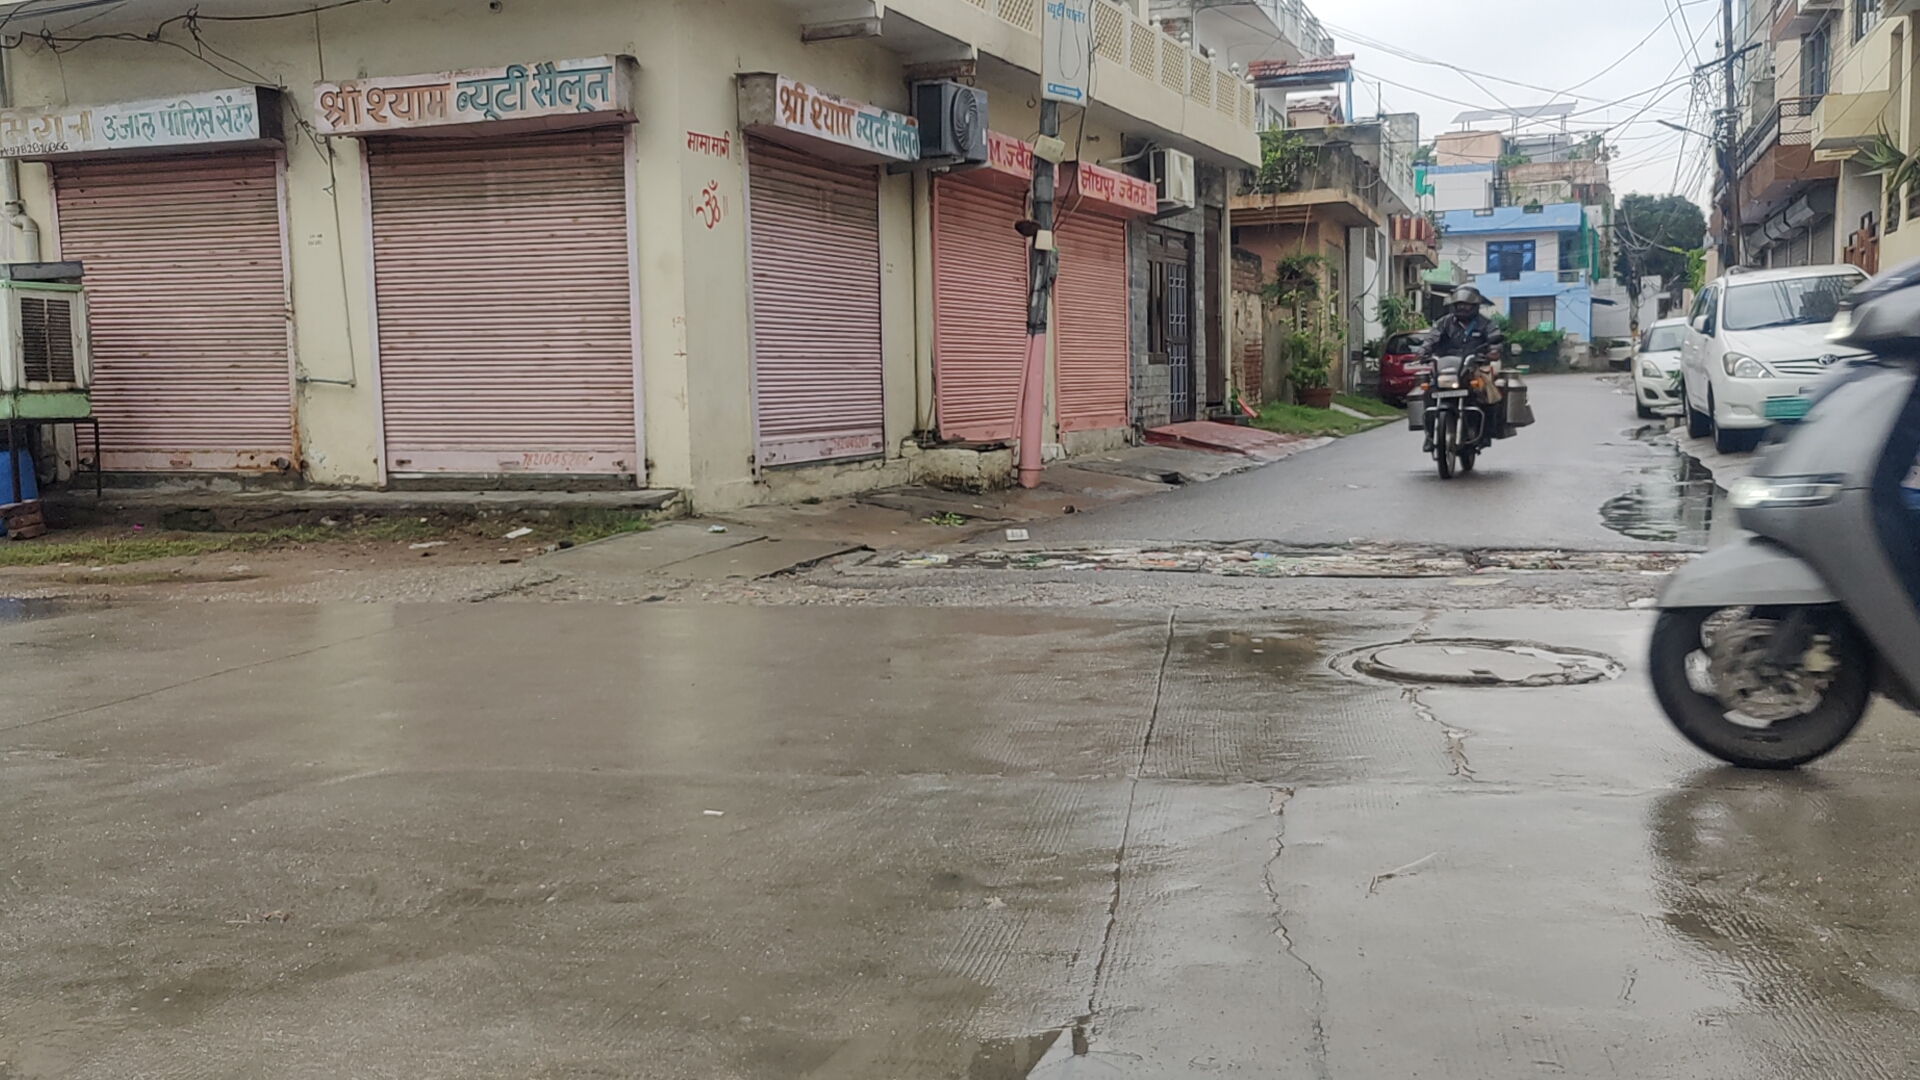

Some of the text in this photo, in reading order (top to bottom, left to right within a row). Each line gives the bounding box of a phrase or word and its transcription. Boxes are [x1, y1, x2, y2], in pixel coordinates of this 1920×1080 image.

[320, 80, 361, 128] श्री
[366, 82, 451, 122] श्याम
[531, 61, 613, 113] सैलून
[780, 82, 809, 125] श्री
[810, 96, 855, 141] श्याम
